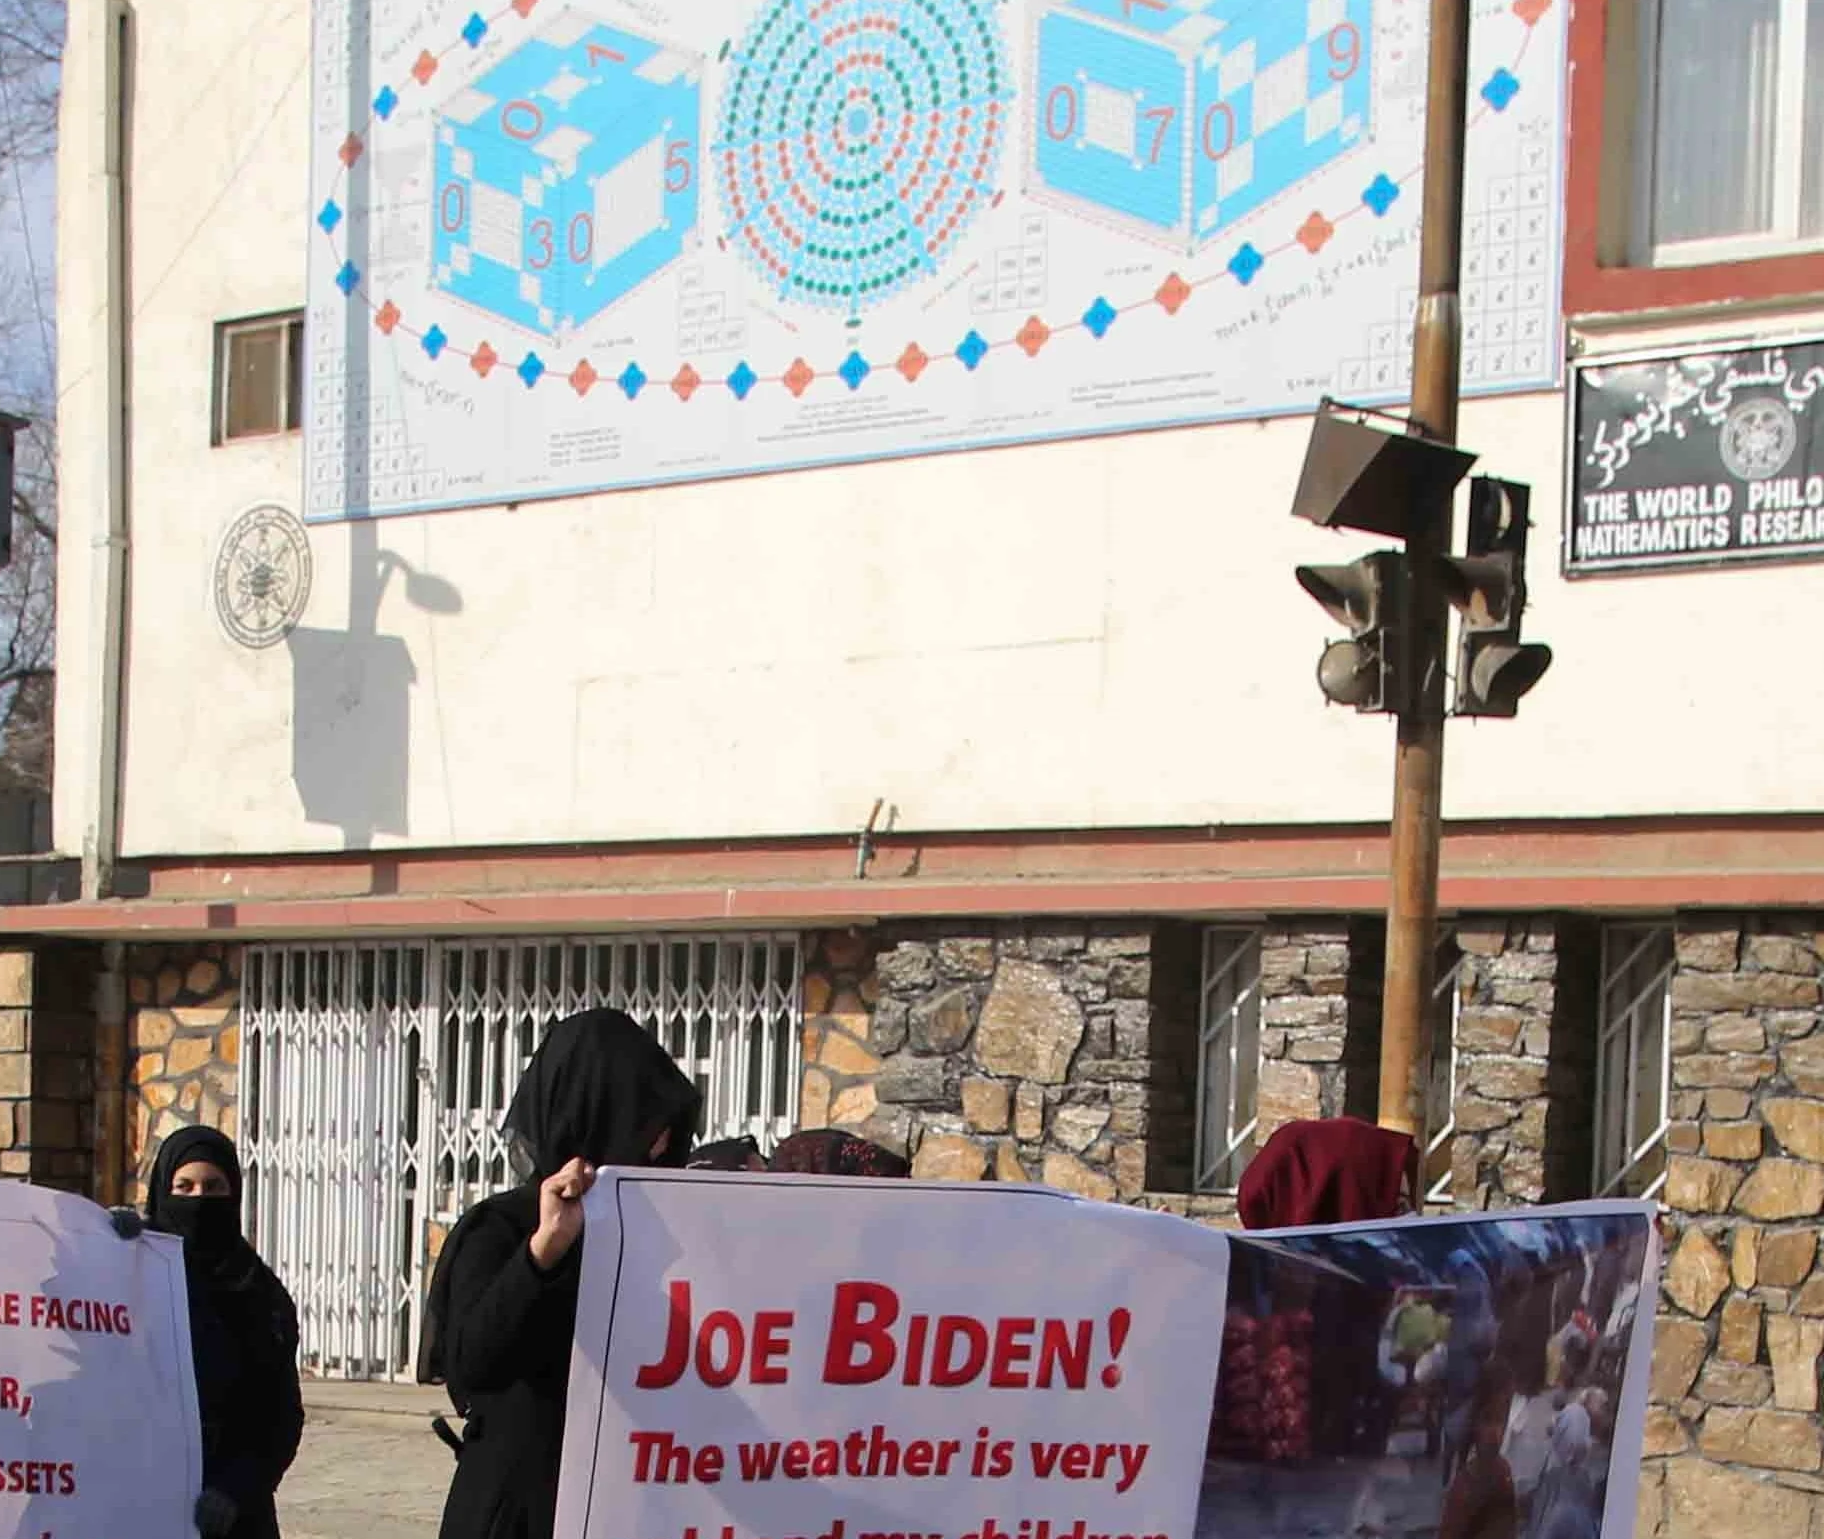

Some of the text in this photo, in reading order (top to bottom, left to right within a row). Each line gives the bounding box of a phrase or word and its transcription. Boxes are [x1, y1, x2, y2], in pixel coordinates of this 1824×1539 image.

[1327, 22, 1360, 81] 9
[1144, 107, 1175, 164] 7
[666, 141, 690, 193] 5
[528, 219, 553, 269] 3
[1584, 492, 1629, 523] THE
[1636, 484, 1732, 519] WORLD
[1577, 515, 1730, 559] MATHEMATICS
[30, 1296, 131, 1335] FACING
[629, 1425, 1149, 1493] The weather is very
